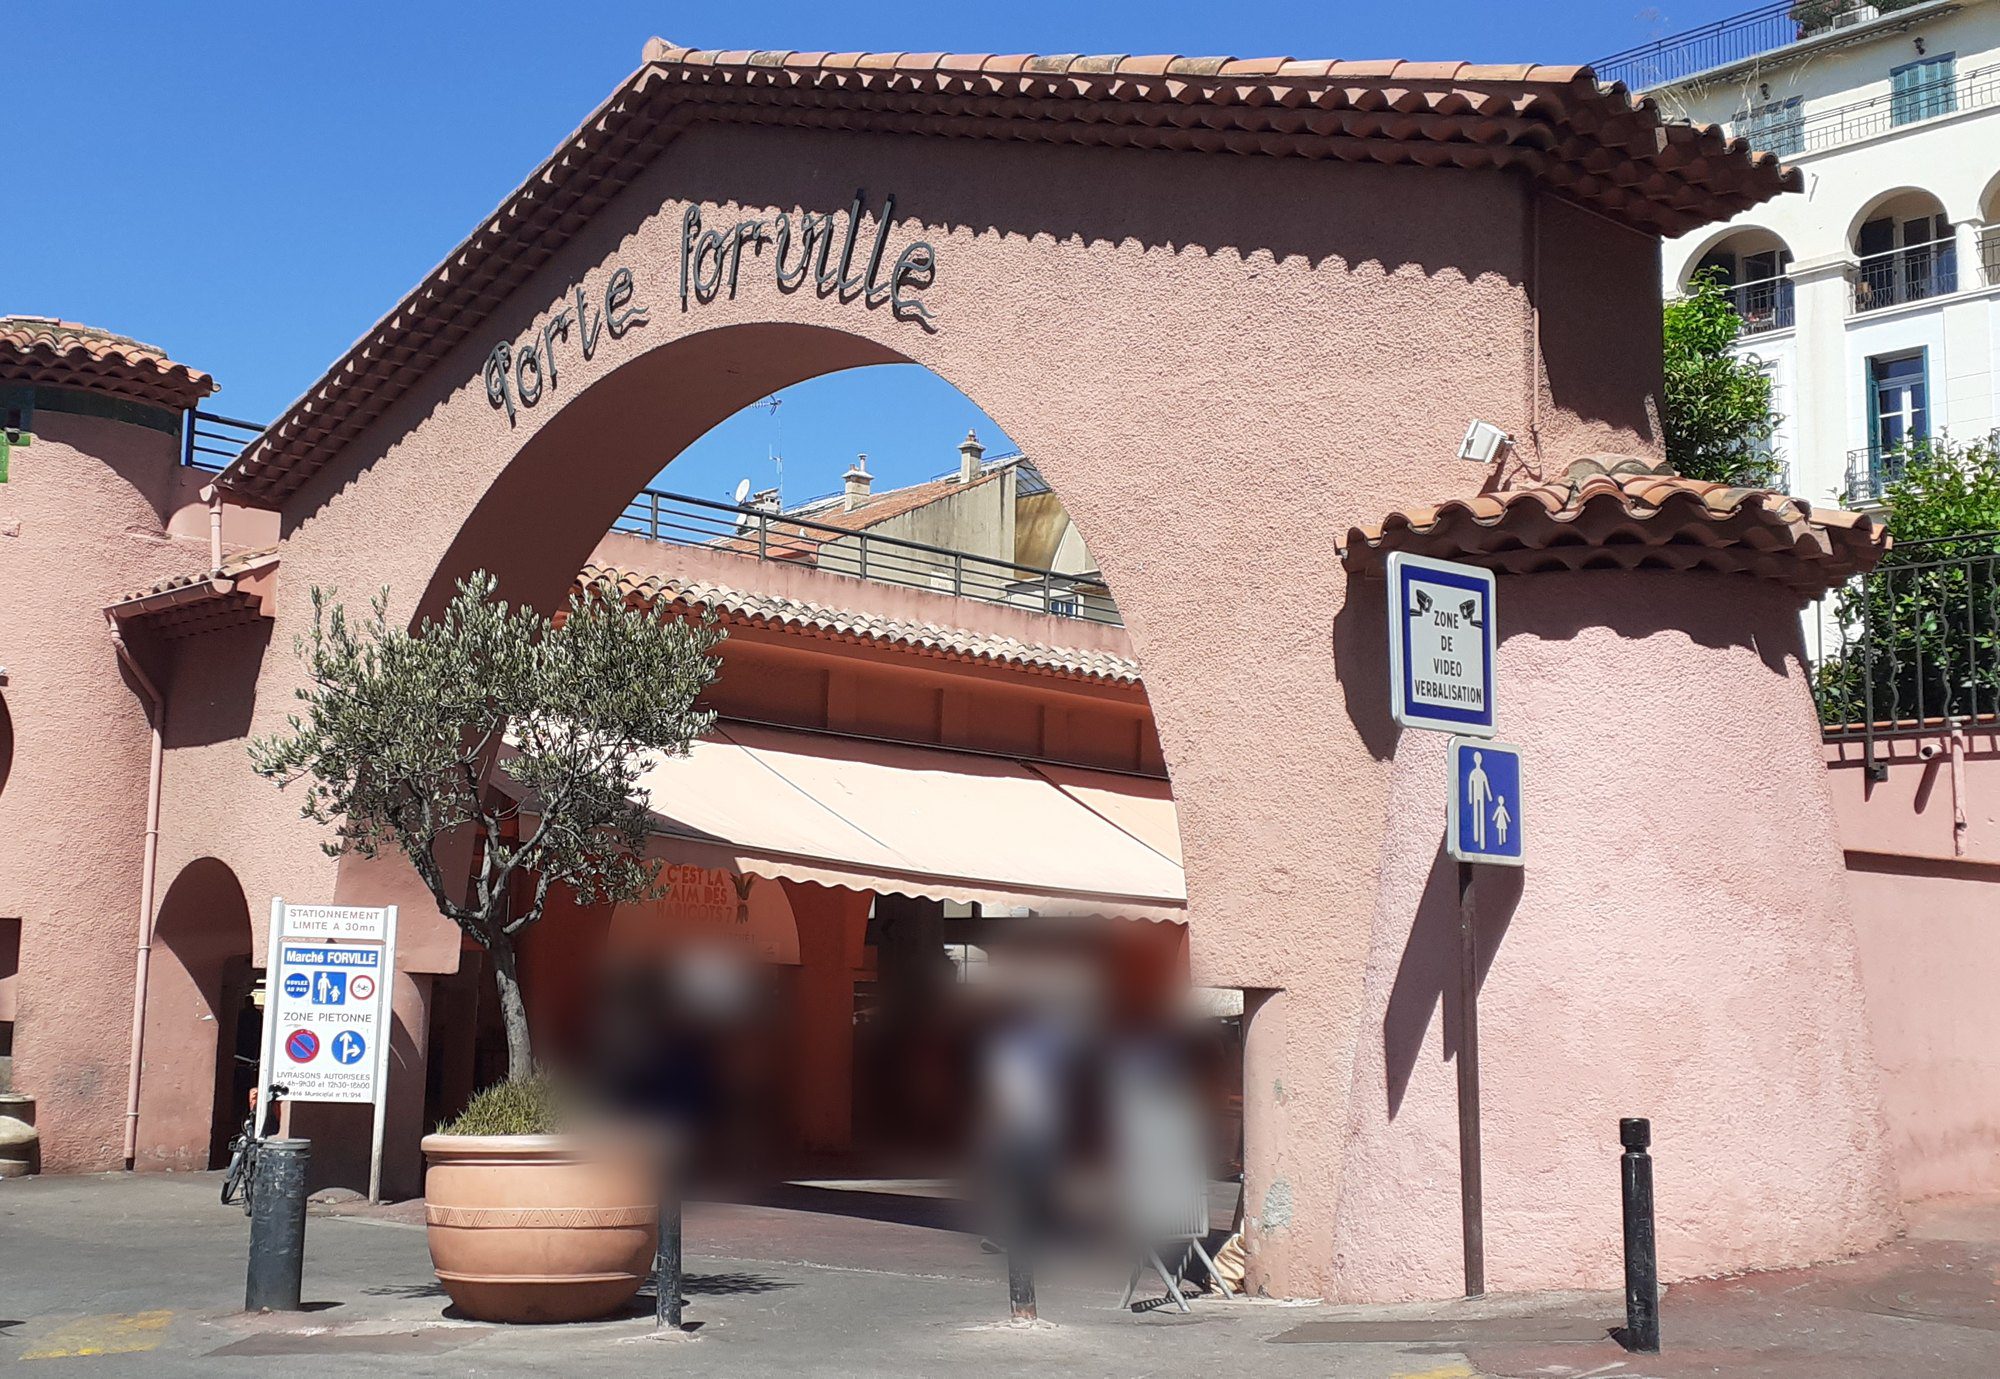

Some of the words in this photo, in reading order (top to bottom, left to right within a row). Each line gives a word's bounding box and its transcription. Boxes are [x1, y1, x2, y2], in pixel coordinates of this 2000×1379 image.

[1434, 610, 1459, 629] ZONE
[1440, 635, 1453, 652] DE
[1433, 657, 1462, 677] VIDEO
[1414, 679, 1482, 704] VERBALISATION
[667, 865, 703, 885] C'EST
[707, 871, 724, 887] LA
[704, 886, 727, 905] DES
[290, 909, 380, 920] STATIONNEMENT
[292, 921, 328, 930] LIMITE
[345, 923, 375, 931] 30mn
[286, 950, 324, 963] Marché
[327, 952, 376, 965] FORVILLE
[283, 1012, 314, 1021] ZONE
[318, 1013, 372, 1022] PIETONNE
